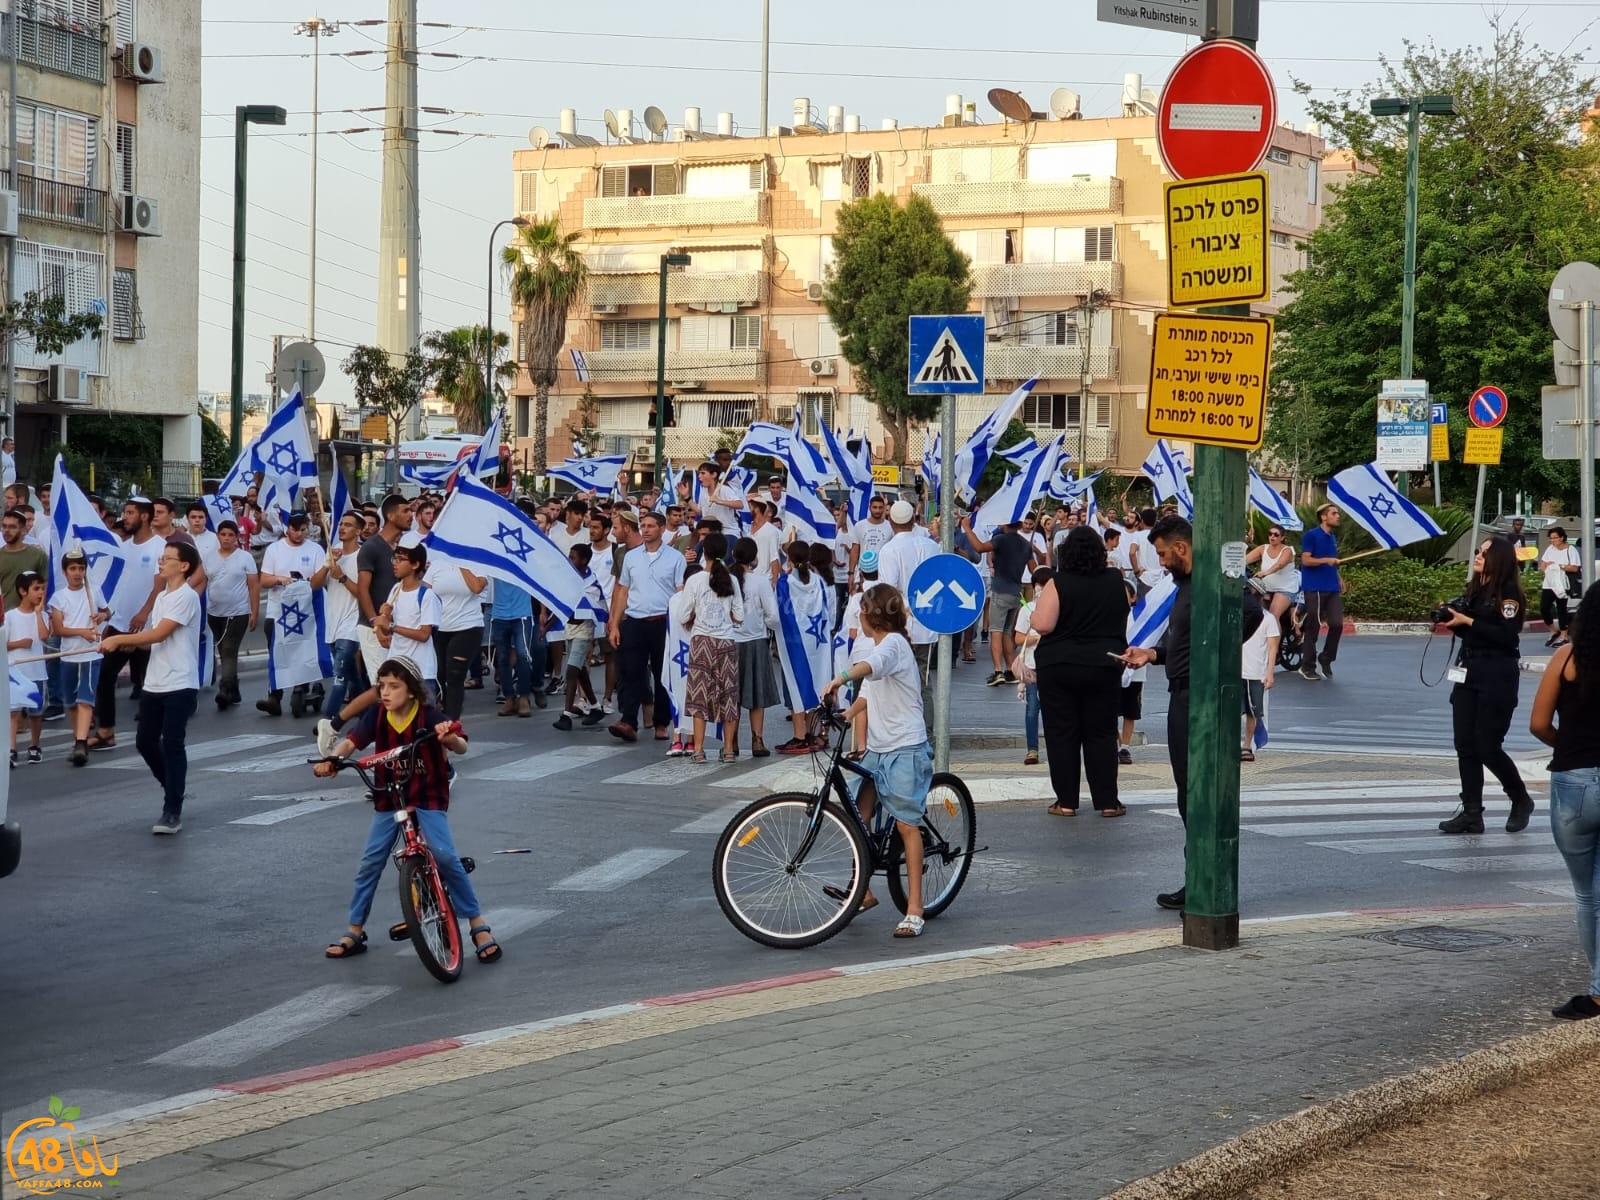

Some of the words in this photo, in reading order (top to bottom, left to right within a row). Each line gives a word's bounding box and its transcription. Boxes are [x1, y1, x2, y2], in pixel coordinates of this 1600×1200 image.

[1113, 6, 1138, 18] Yitshak
[1139, 7, 1188, 26] Rubinstein
[1189, 17, 1199, 28] St.
[1173, 198, 1216, 223] לרכב
[1221, 197, 1260, 218] פרט
[1191, 232, 1241, 253] ציבורי
[1181, 265, 1252, 288] ומשטרה
[1168, 327, 1208, 343] מותרת
[1211, 329, 1254, 345] הכניסה
[1185, 349, 1207, 363] רכב
[1211, 348, 1233, 364] לכל
[1155, 367, 1169, 380] חג
[1172, 368, 1201, 384] וערבי
[1204, 371, 1231, 385] שישי
[1235, 373, 1259, 387] בימי
[1171, 389, 1204, 404] 18:00
[1207, 391, 1245, 407] משעה
[1155, 407, 1196, 423] למחרת
[1200, 412, 1234, 427] 16:00
[1237, 415, 1254, 430] עד
[384, 758, 425, 770] QATR
